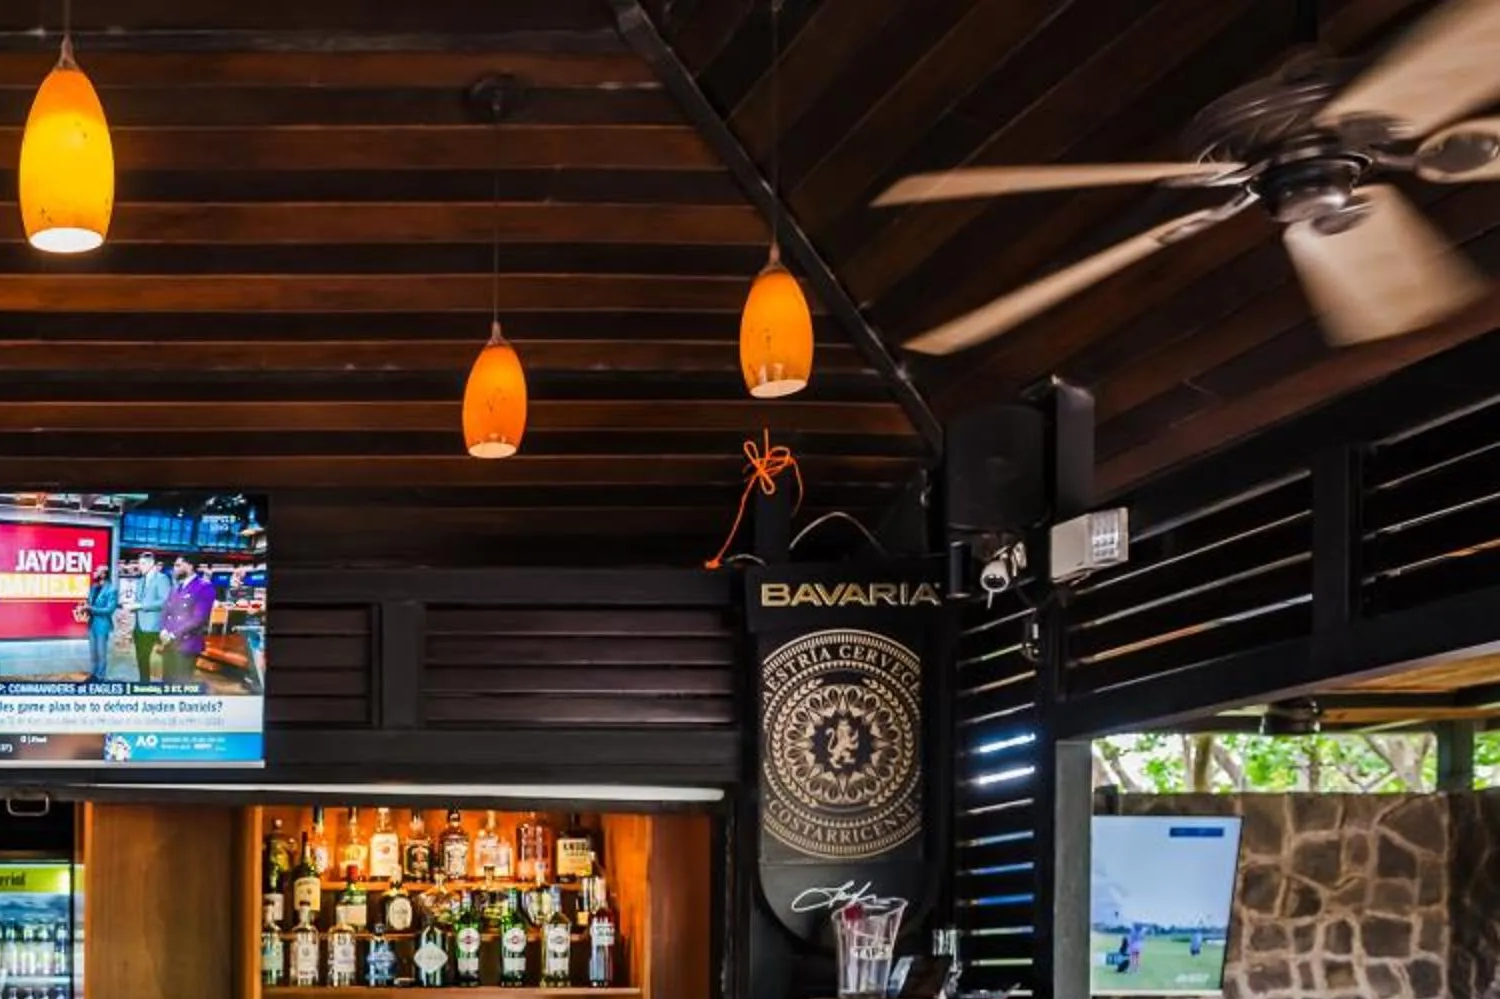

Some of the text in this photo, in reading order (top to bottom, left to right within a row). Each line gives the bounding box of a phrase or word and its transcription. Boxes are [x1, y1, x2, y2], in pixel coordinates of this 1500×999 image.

[14, 549, 93, 573] JAYDEN
[760, 582, 941, 607] BAVARIA
[8, 683, 76, 694] COMMANDERS
[89, 683, 124, 695] EAGLES
[17, 703, 45, 714] game
[49, 701, 72, 714] plan
[73, 701, 88, 713] be
[89, 702, 101, 713] to
[103, 701, 139, 713] defend
[141, 701, 176, 715] Jayden
[179, 701, 223, 713] Daniels?
[135, 735, 159, 747] AO
